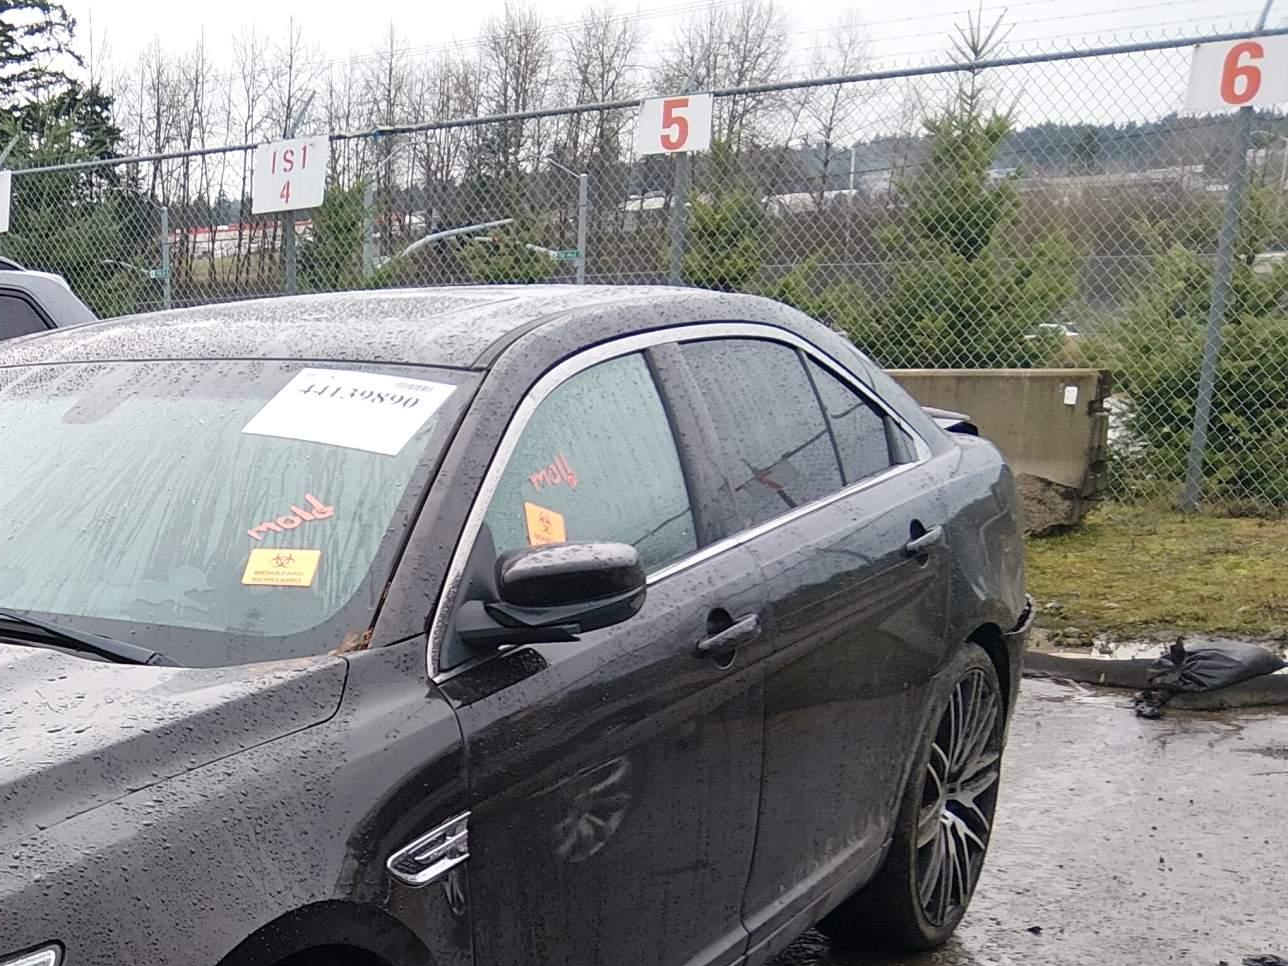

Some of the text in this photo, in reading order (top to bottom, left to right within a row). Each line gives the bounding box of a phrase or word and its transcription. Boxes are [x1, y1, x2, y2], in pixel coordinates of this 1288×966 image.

[1219, 41, 1263, 105] 6
[659, 98, 689, 151] 5
[279, 180, 291, 204] 4
[247, 493, 334, 541] mold
